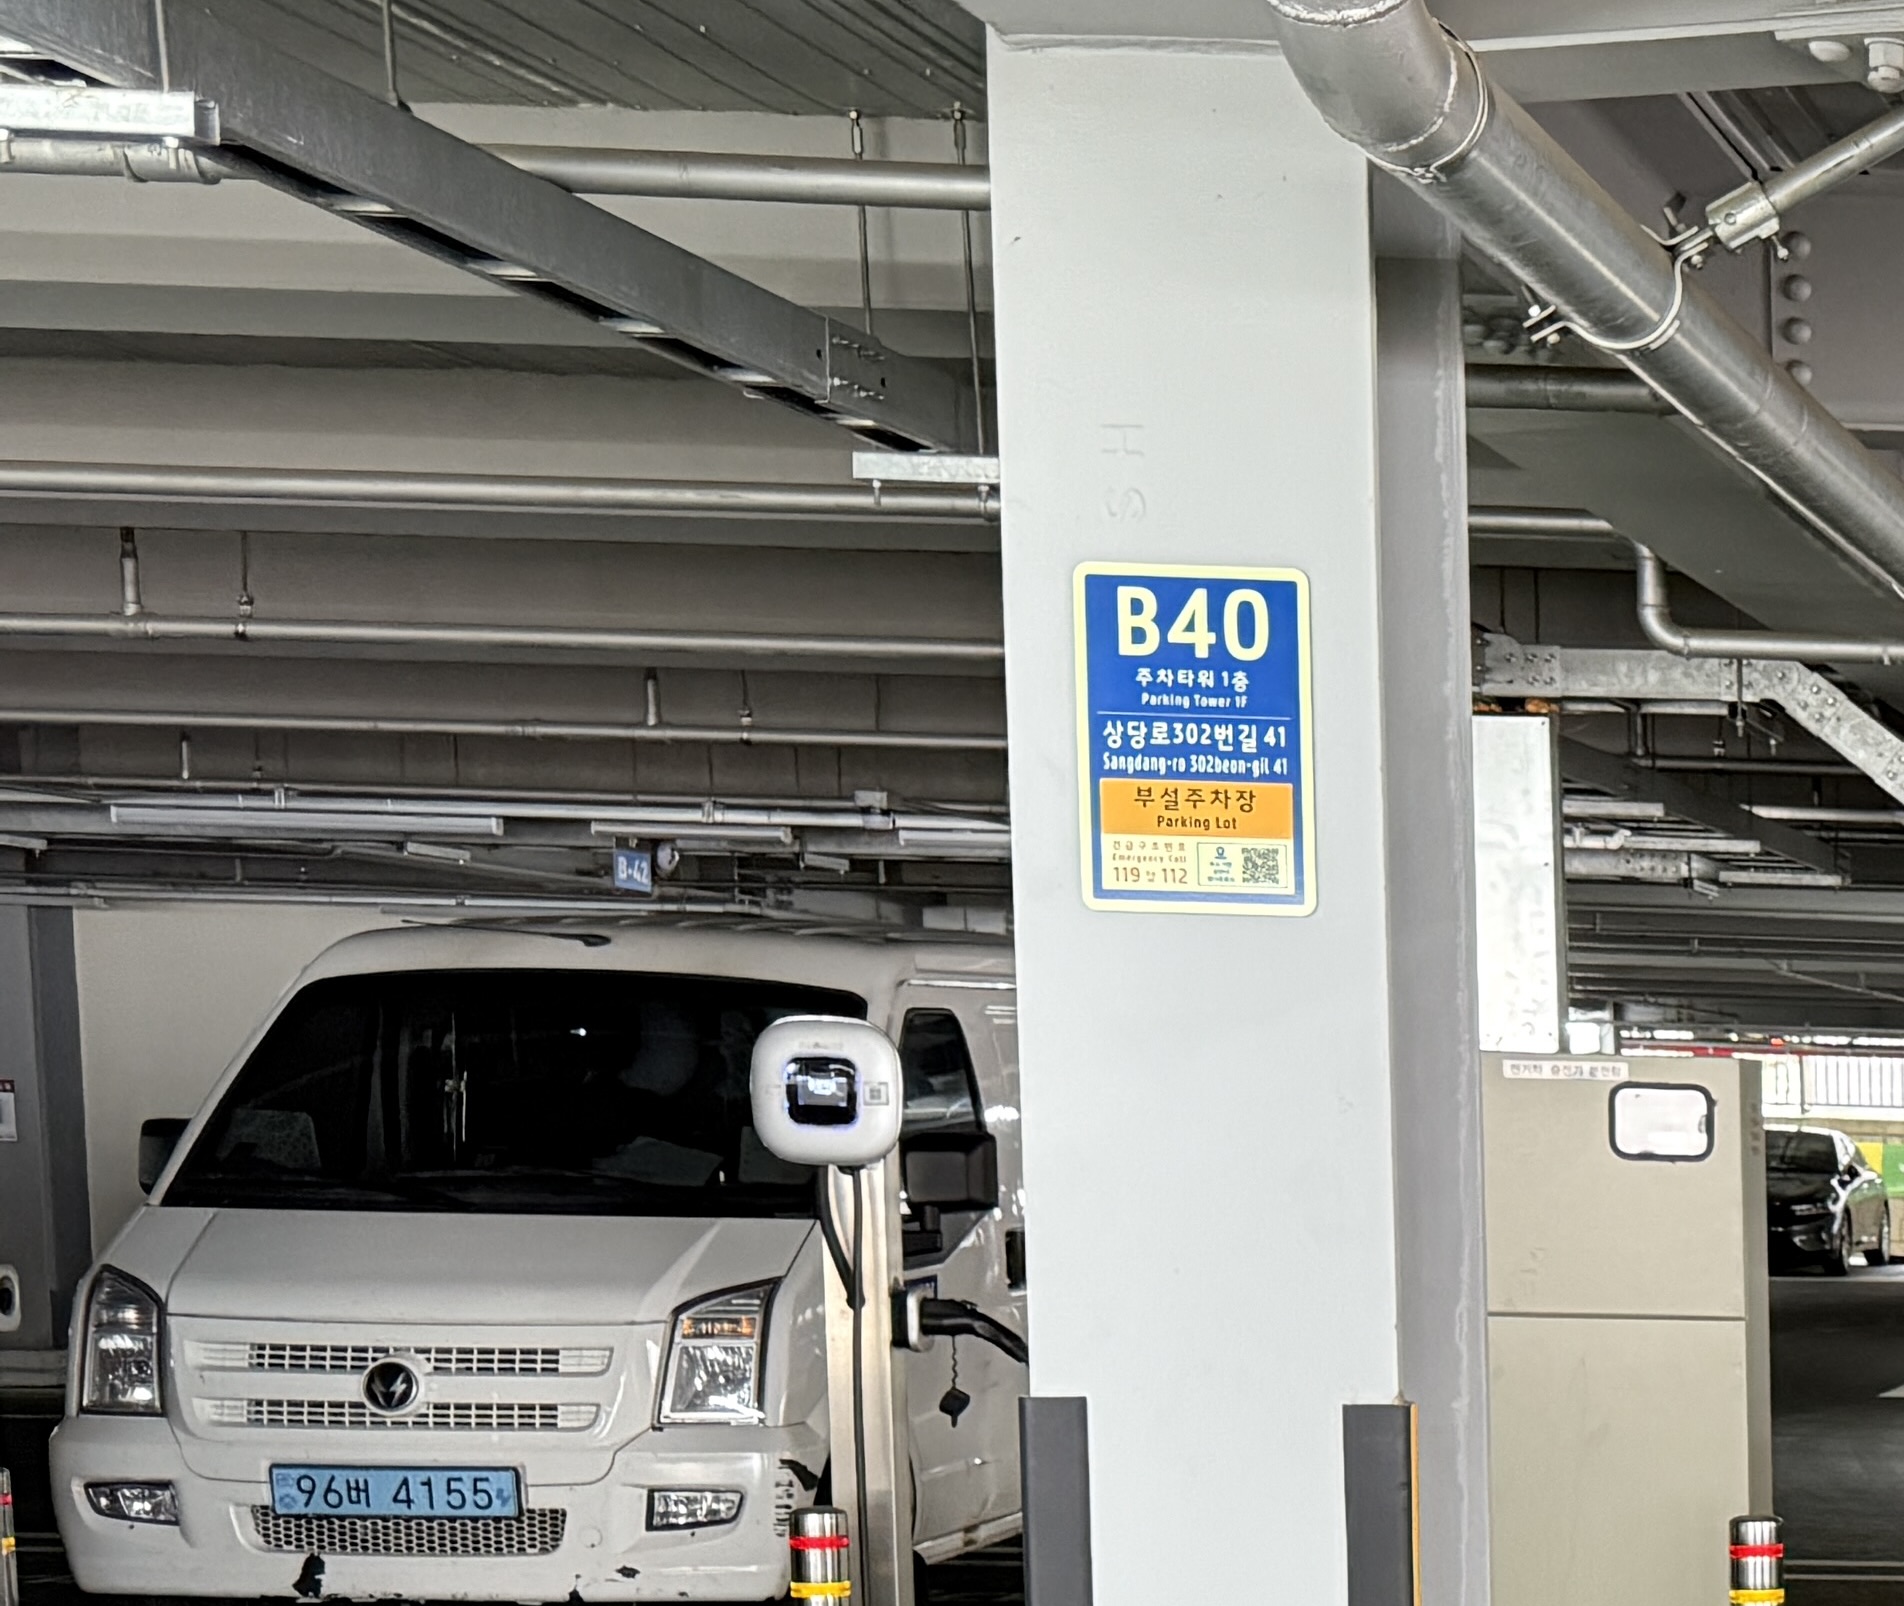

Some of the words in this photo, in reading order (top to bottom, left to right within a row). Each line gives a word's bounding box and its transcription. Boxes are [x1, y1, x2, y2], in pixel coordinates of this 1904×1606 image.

[1116, 585, 1270, 662] B40
[1135, 667, 1215, 689] 주차타워
[1221, 670, 1250, 693] 1층
[1141, 692, 1190, 709] Parking
[1194, 694, 1231, 708] Tower
[1102, 720, 1258, 753] 상당로302번길
[1263, 726, 1286, 748] 41
[1102, 752, 1186, 775] Sangdang-ro
[1190, 754, 1270, 778] 302beon-gil
[1273, 757, 1288, 775] 41
[1134, 786, 1257, 813] 부설주차장
[1157, 815, 1211, 831] Parking
[1215, 817, 1238, 830] Lot
[1113, 866, 1141, 883] 119
[1162, 868, 1189, 885] 112
[296, 1474, 371, 1509] 96버
[392, 1475, 493, 1511] 4155
